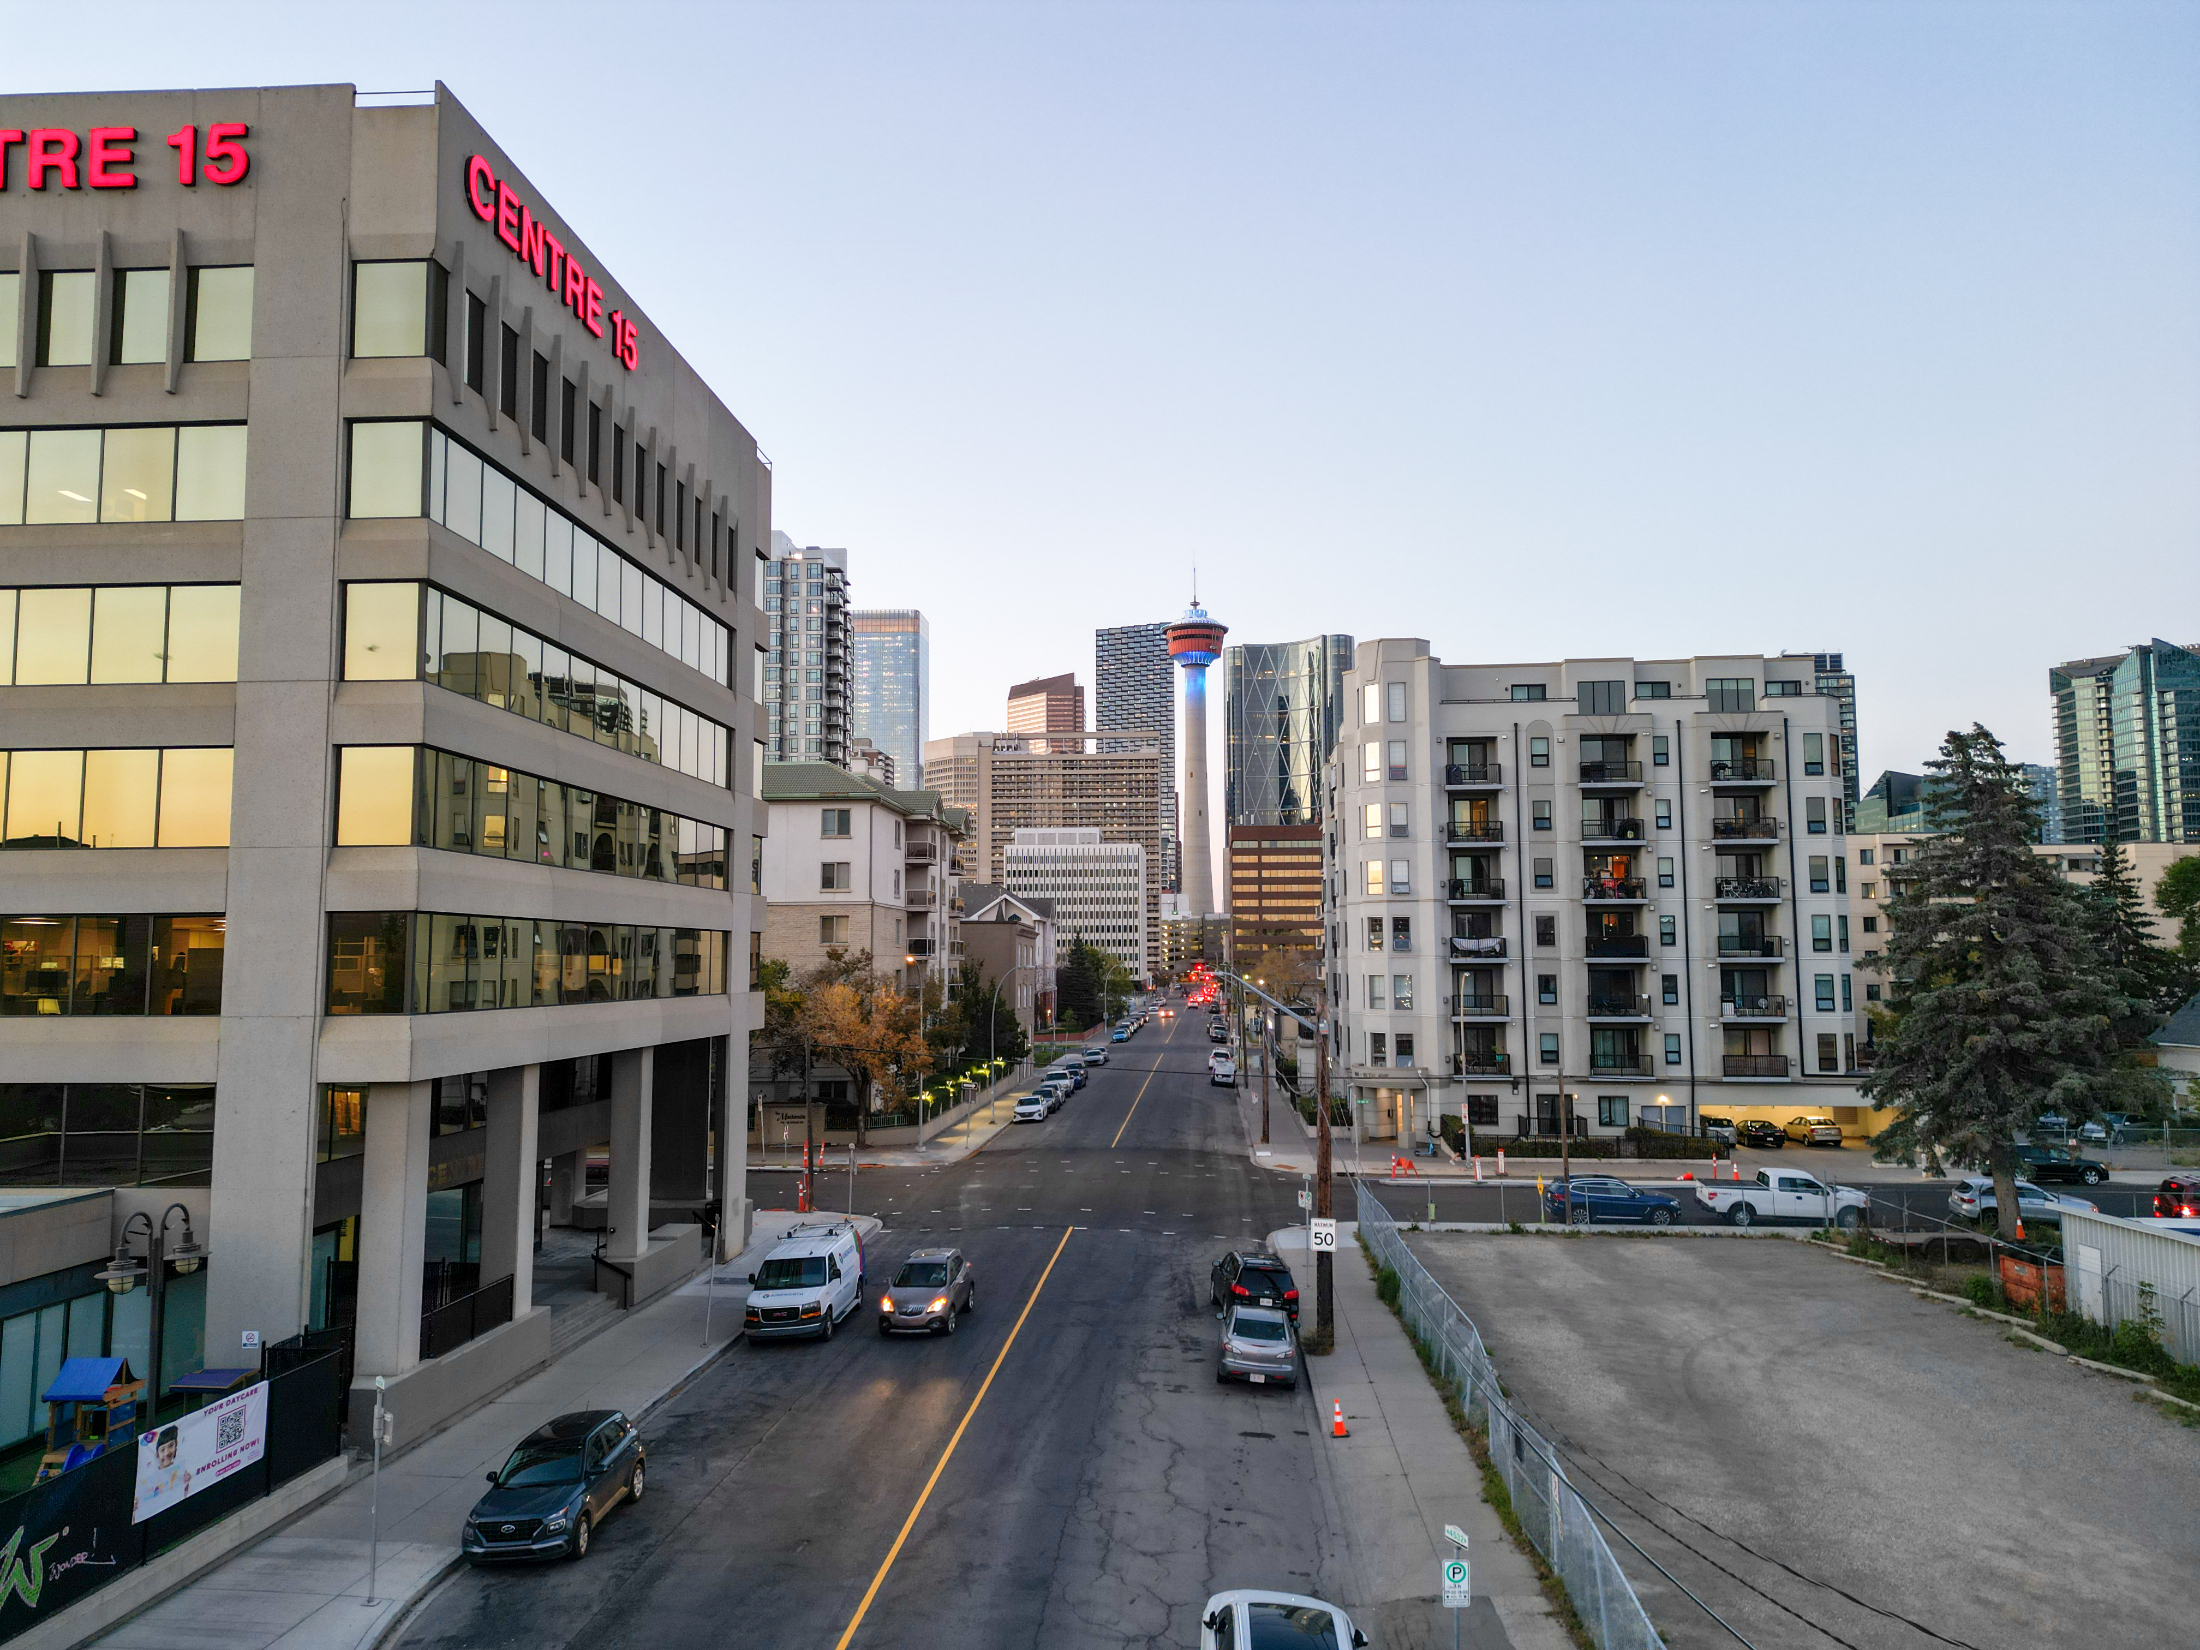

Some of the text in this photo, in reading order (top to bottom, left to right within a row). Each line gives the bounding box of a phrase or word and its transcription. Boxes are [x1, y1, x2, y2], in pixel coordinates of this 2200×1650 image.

[166, 122, 250, 186] 15
[465, 154, 639, 371] CENTRE 15
[1314, 1232, 1334, 1246] 50
[203, 1387, 259, 1417] YOUR DAYCARE
[196, 1448, 238, 1476] ENROLLING
[1452, 1566, 1462, 1579] P
